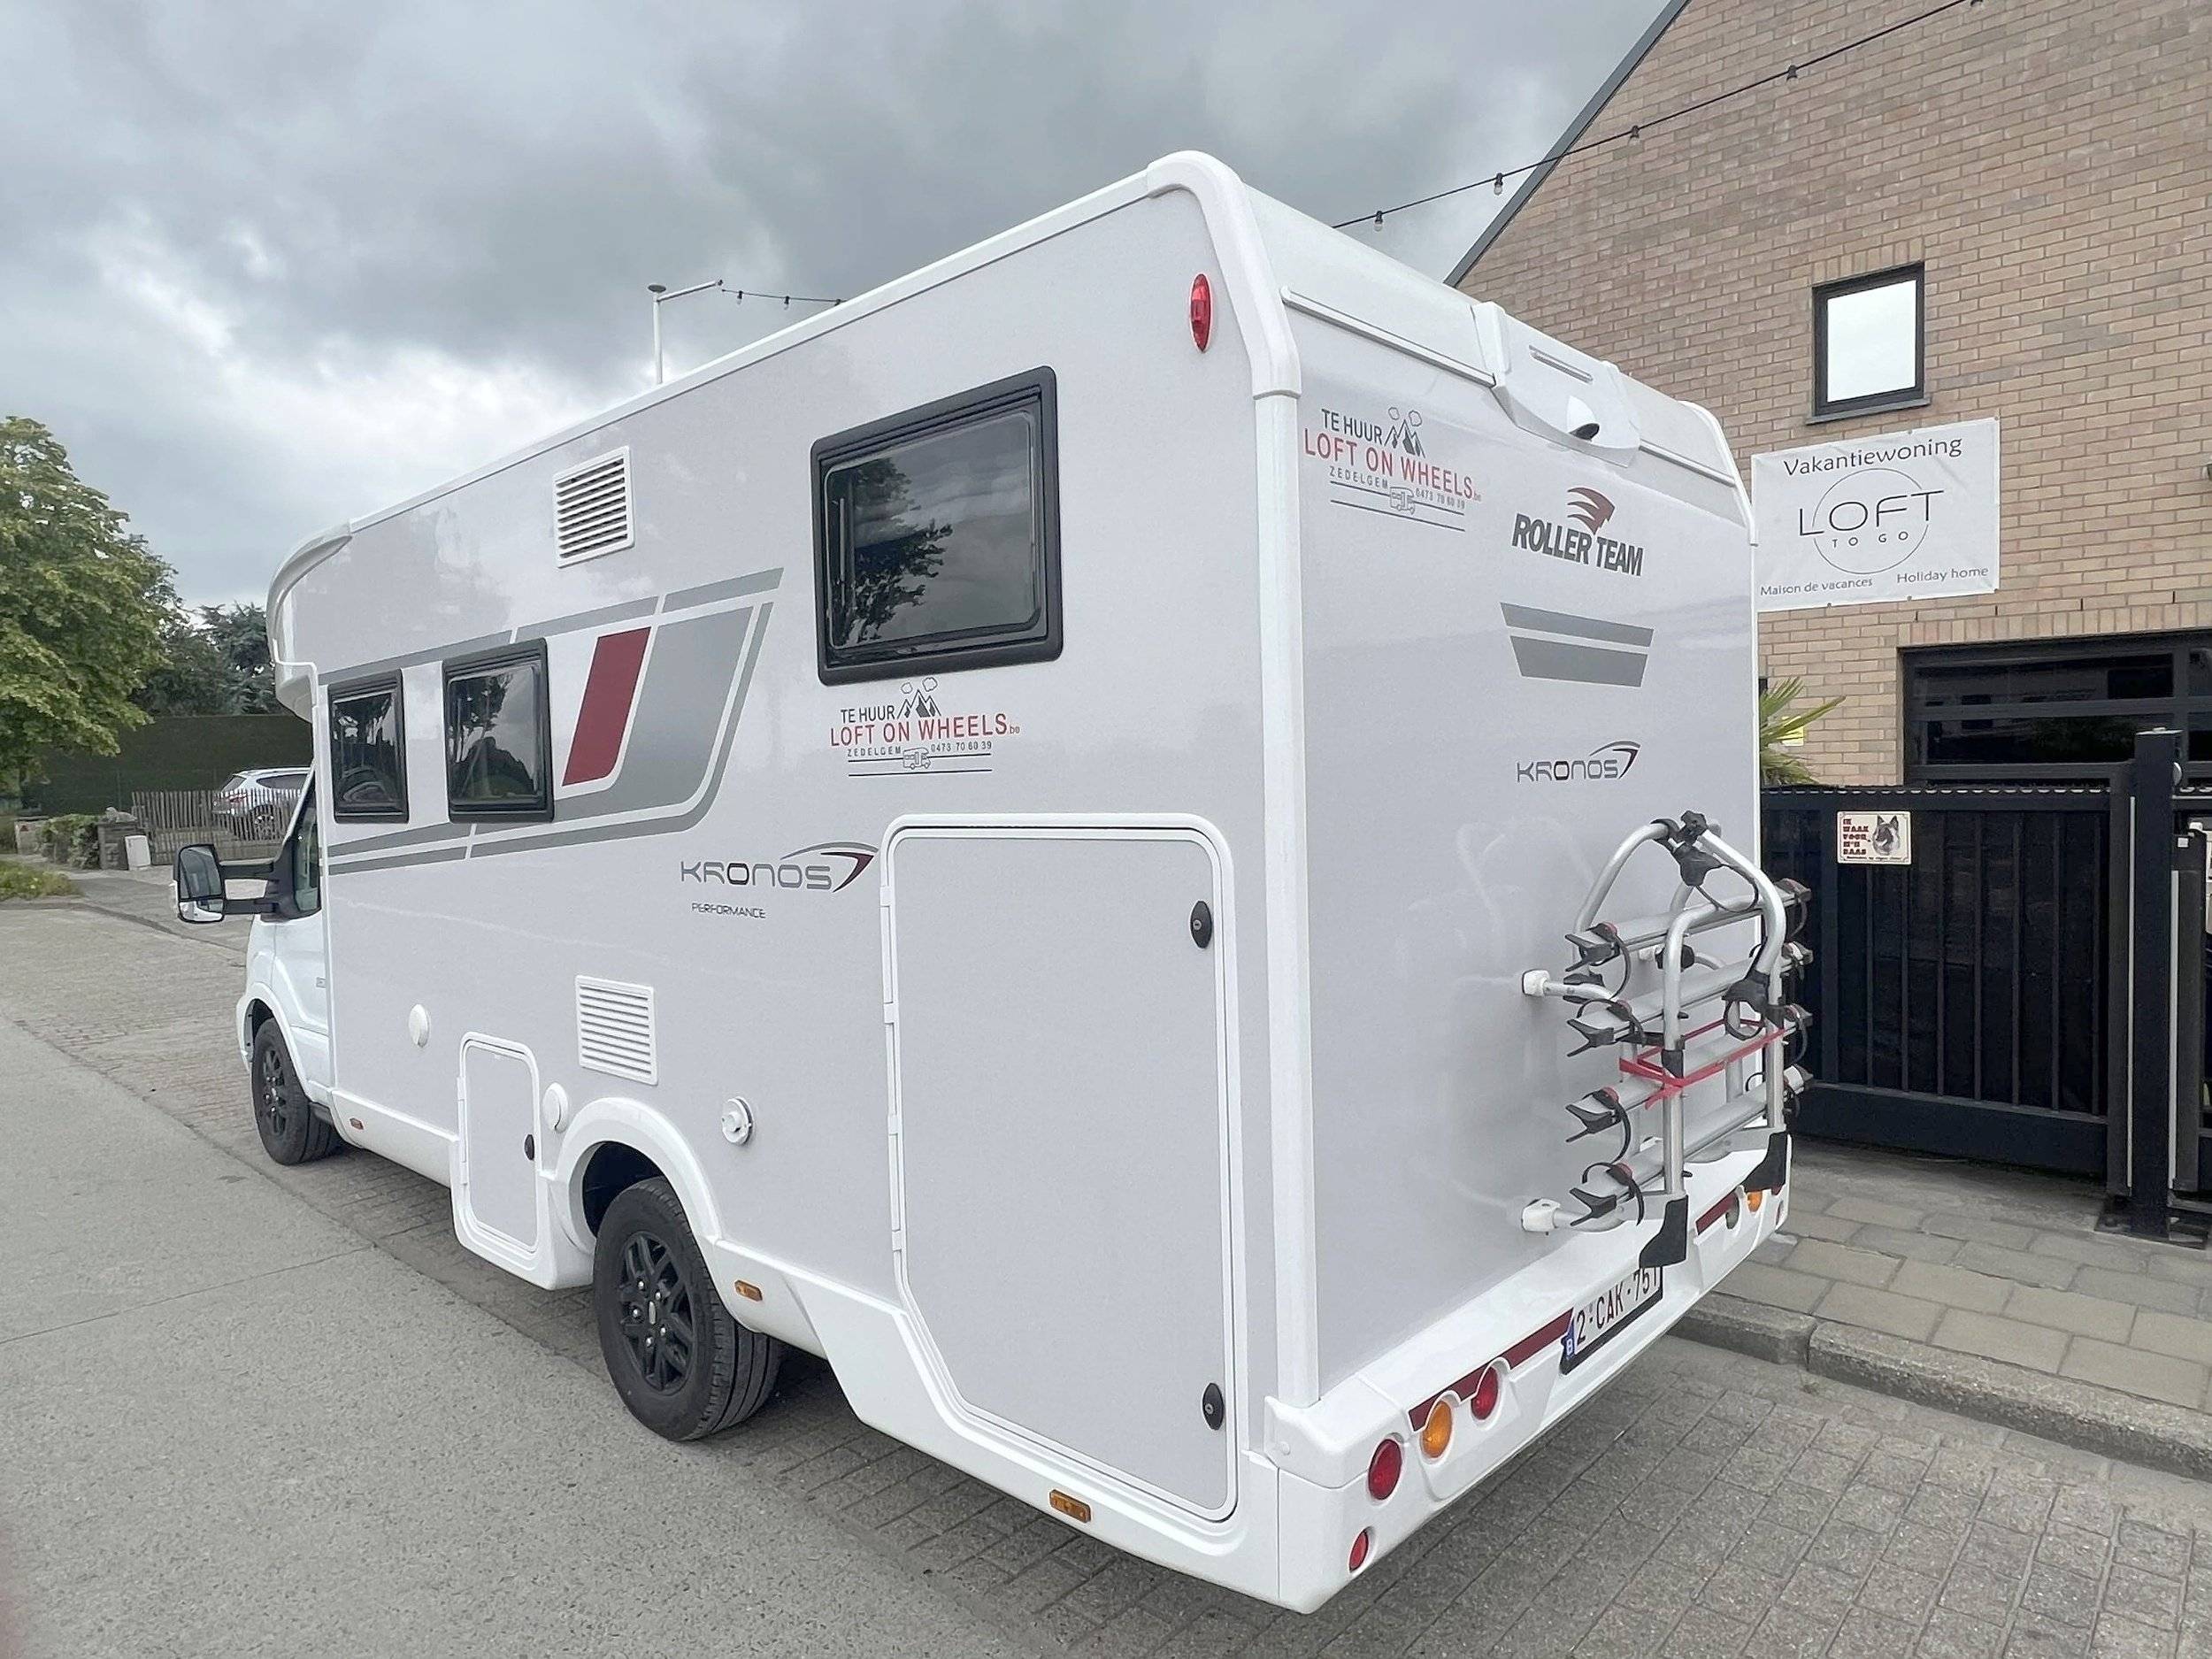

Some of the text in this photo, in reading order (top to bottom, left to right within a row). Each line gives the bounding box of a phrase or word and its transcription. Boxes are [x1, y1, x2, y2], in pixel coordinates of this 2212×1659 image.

[1321, 408, 1382, 445] TE HUUR
[1304, 428, 1357, 466] LOFT
[1365, 447, 1393, 476] ON
[1783, 438, 1962, 476] Vakantiewoning
[1329, 465, 1388, 489] ZEDELGEM
[1799, 490, 1944, 536] LOFT
[1511, 513, 1644, 577] ROLLER TEAM
[1832, 530, 1909, 549] TO GO
[1897, 566, 1989, 584] Holiday home
[1760, 579, 1873, 596] Maison de vacances
[841, 705, 895, 724] TE HUUR
[830, 724, 875, 747] LOFT
[883, 721, 910, 743] ON
[847, 746, 902, 757] ZEDELGEM
[931, 743, 951, 753] 0473
[956, 742, 965, 751] 70
[981, 740, 992, 750] 39
[1517, 759, 1619, 783] KRONOS
[680, 860, 833, 890] KRONOS
[692, 902, 766, 919] PERFORMANCE
[1566, 1338, 1573, 1356] B
